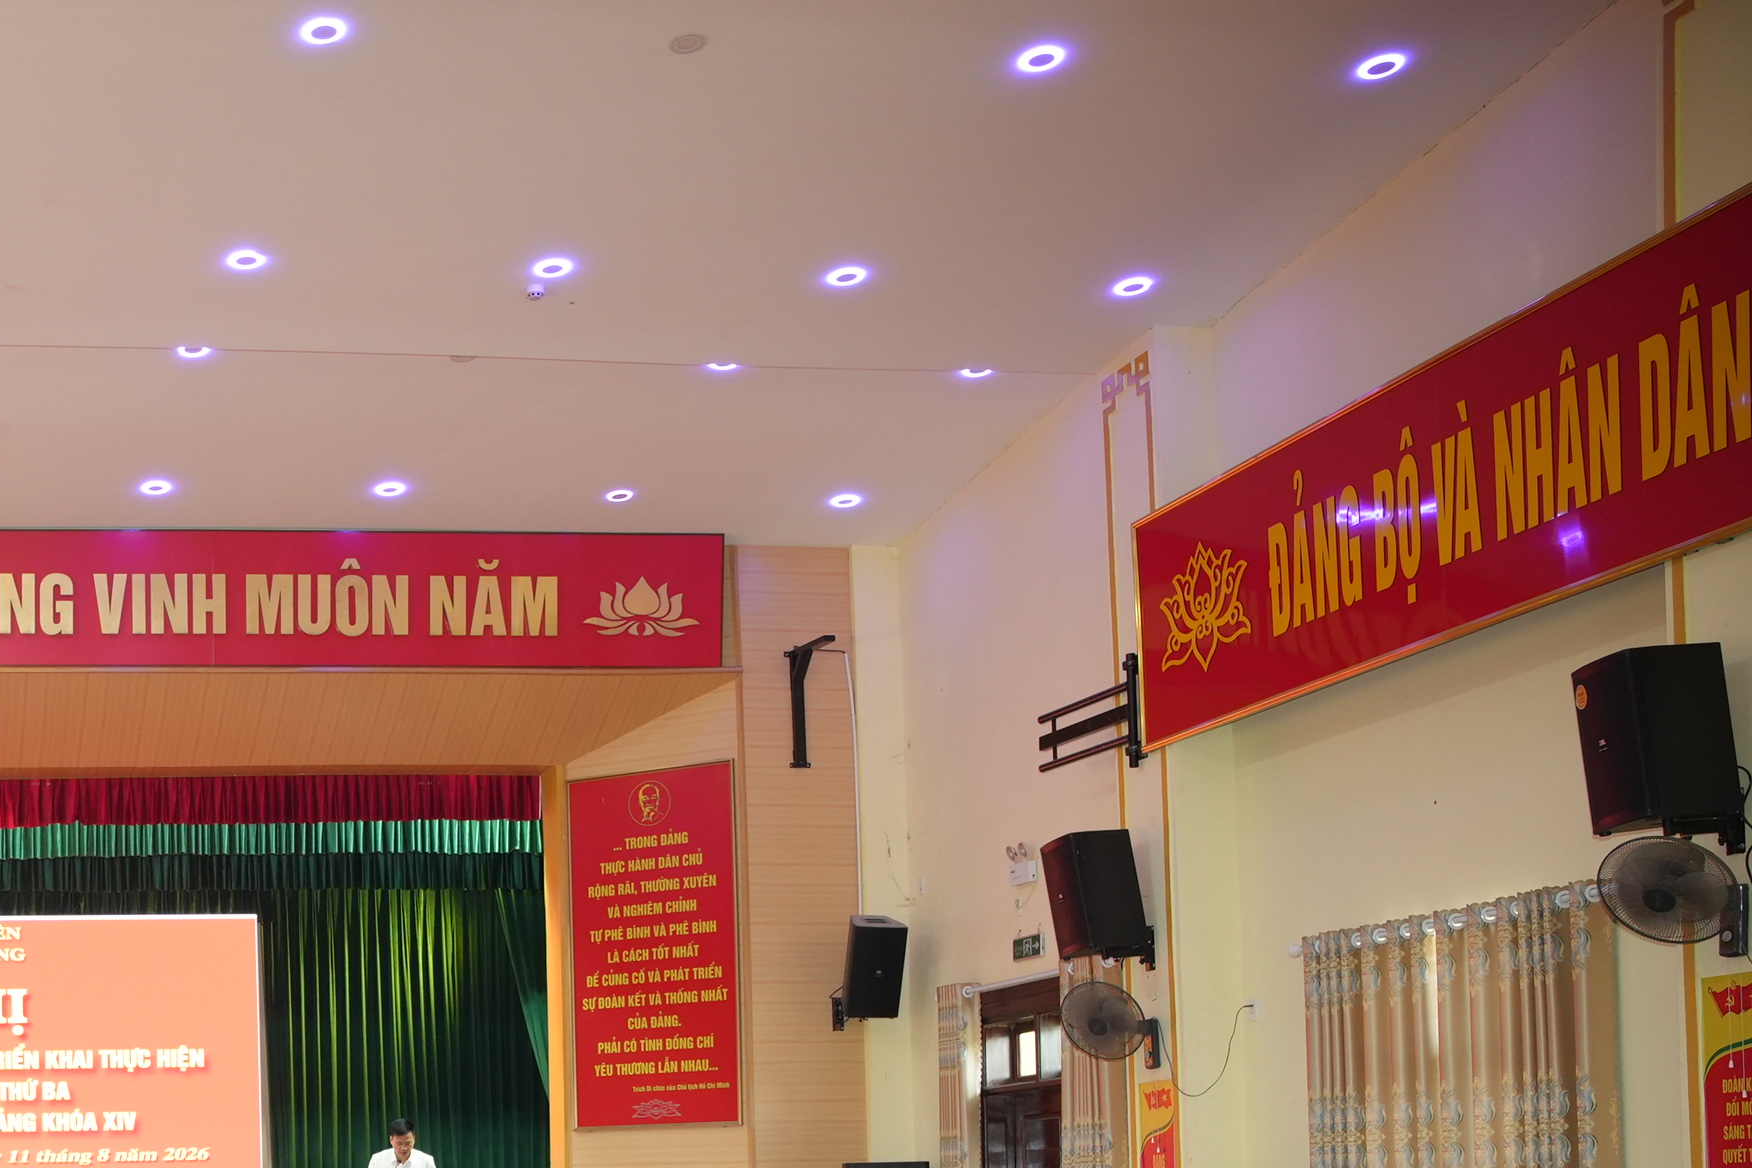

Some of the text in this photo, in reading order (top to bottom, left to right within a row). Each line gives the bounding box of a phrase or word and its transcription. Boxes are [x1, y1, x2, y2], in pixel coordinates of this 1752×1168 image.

[1267, 283, 1752, 638] ĐẢNG BỘ VÀ NHÂN DÂN
[94, 572, 226, 636] VINH
[246, 558, 410, 636] MUÔN
[429, 558, 558, 638] NĂM
[625, 835, 658, 850] TRONG
[660, 828, 688, 846] ĐẢNG
[600, 848, 703, 876] THỰC HÀNH DÂN CHỦ
[588, 883, 615, 900] RỘNG
[640, 876, 680, 893] THƯỜNG
[683, 872, 717, 889] XUYÊN
[608, 896, 697, 919] VÀ NGHIÊM CHỈNH
[590, 919, 717, 945] TỰ PHÊ BÌNH VÀ PHÊ BÌNH
[608, 941, 699, 964] LÀ CÁCH TỐT NHẤT
[602, 969, 629, 987] CỦNG
[632, 967, 646, 985] CỐ
[648, 968, 662, 983] VÀ
[664, 966, 690, 982] PHÁT
[582, 984, 728, 1012] SỰ ĐOÀN KẾT VÀ THỐNG NHẤT
[628, 1012, 648, 1030] CỦA
[598, 1036, 621, 1054] PHẢI
[624, 1037, 637, 1053] CÓ
[639, 1037, 663, 1052] TÌNH
[697, 1032, 714, 1048] CHÍ
[45, 1050, 93, 1070] KHAI
[98, 1047, 151, 1072] THỰC
[156, 1045, 205, 1072] HIỆN
[594, 1062, 613, 1077] YÊU
[616, 1061, 655, 1076] THƯƠNG
[42, 1081, 71, 1100] BA
[42, 1108, 98, 1132] KHÓA
[103, 1111, 137, 1131] XIV
[1723, 1122, 1745, 1140] SÁNG
[8, 1149, 30, 1163] 11
[36, 1149, 93, 1166] tháng
[97, 1148, 110, 1162] 8
[114, 1148, 158, 1162] năm
[162, 1147, 210, 1161] 2026
[1722, 1144, 1747, 1165] QUYẾT
